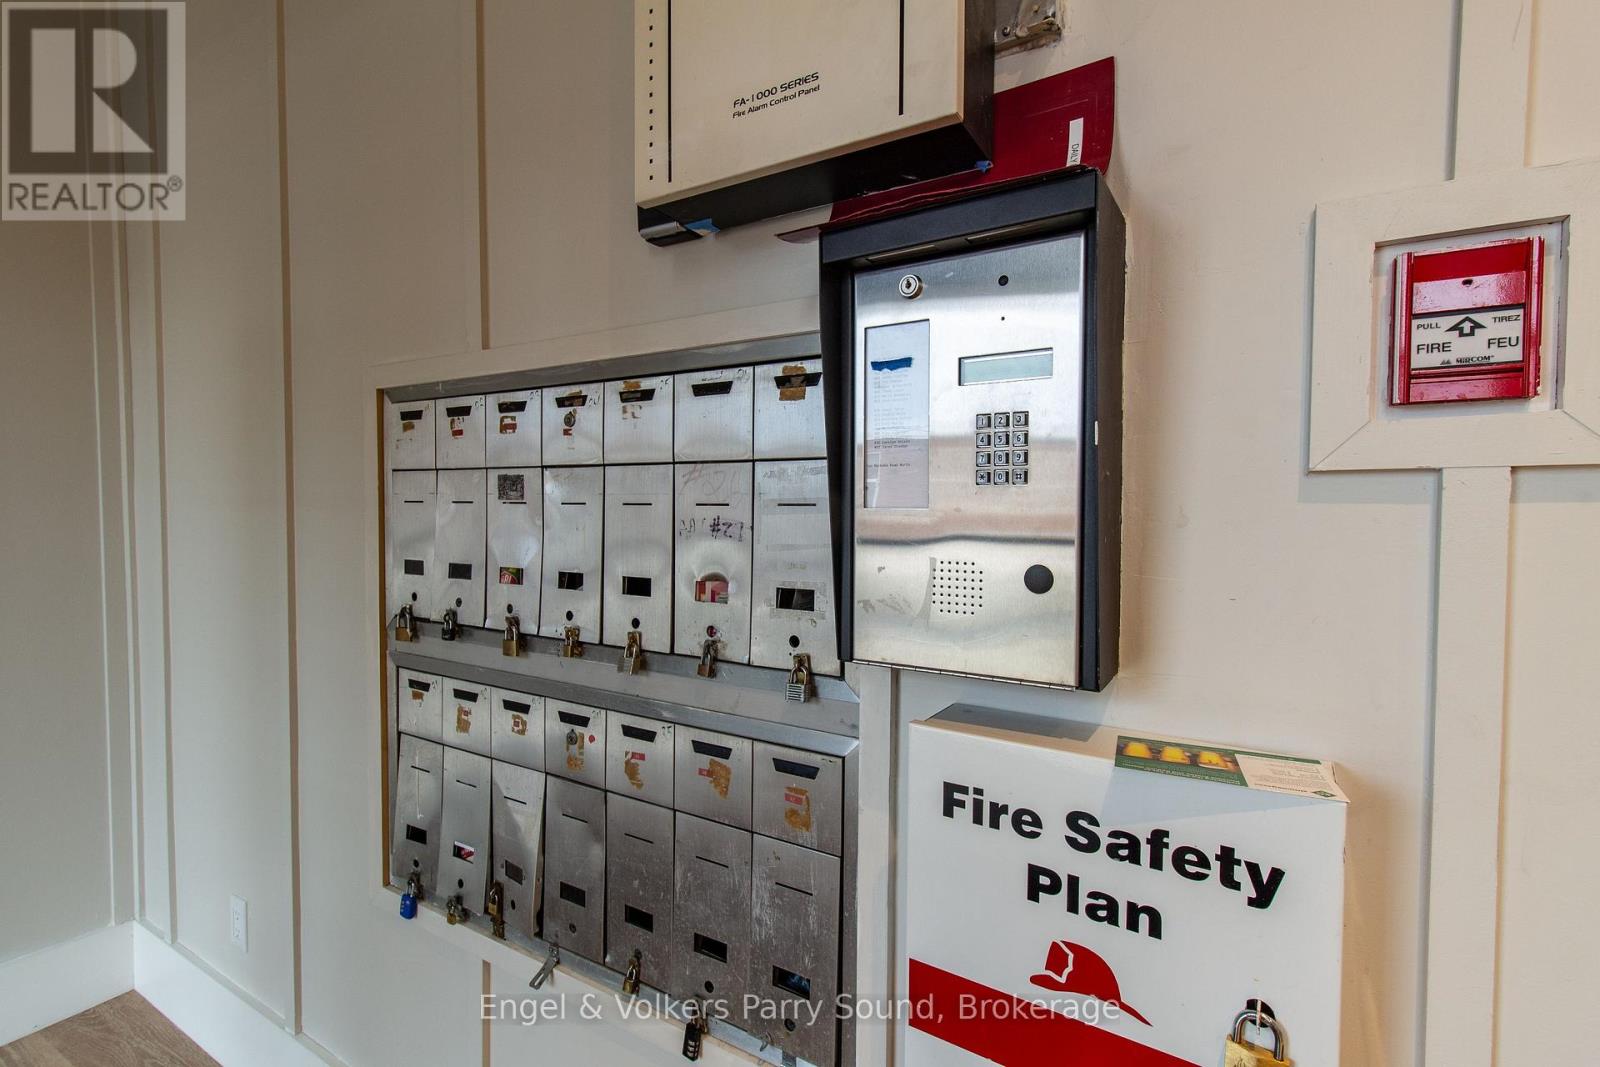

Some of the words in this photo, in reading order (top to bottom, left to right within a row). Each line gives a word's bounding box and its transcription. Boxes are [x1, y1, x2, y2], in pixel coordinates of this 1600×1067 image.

[780, 72, 819, 93] SERIES
[732, 110, 746, 119] Fire
[747, 103, 768, 114] Alarm
[769, 92, 797, 107] Control
[798, 84, 820, 97] Panel
[1416, 322, 1441, 331] PULL
[1492, 314, 1521, 324] TIREZ
[1416, 341, 1452, 355] FIRE
[1487, 336, 1520, 349] FEU
[943, 781, 1043, 840] Fire
[1064, 810, 1286, 910] Safety
[1026, 862, 1163, 941] Plan
